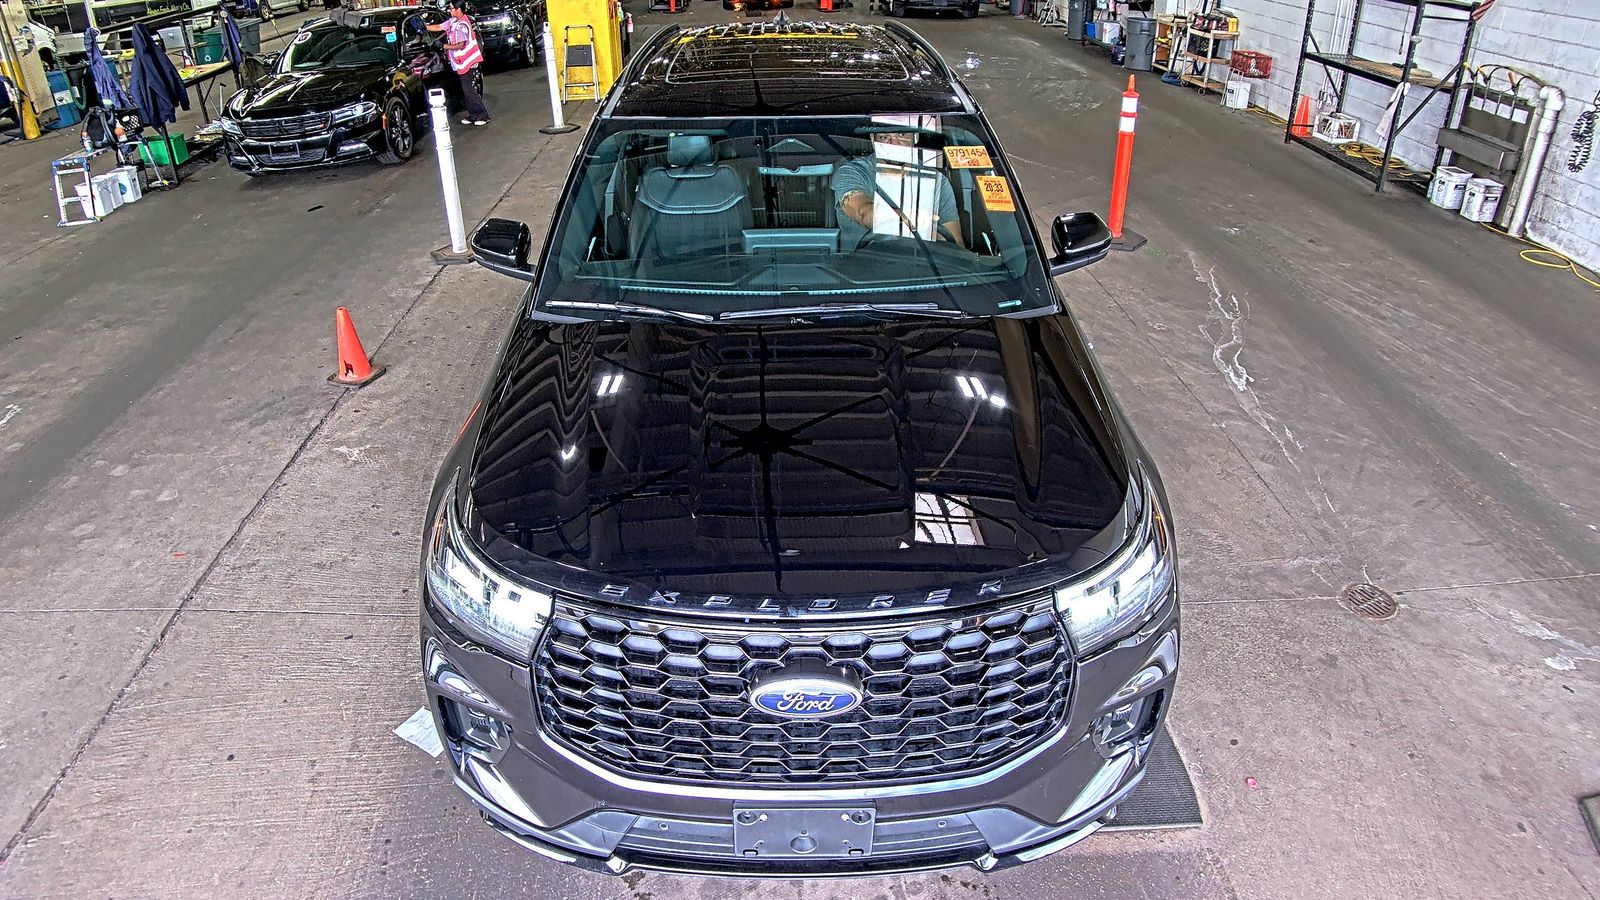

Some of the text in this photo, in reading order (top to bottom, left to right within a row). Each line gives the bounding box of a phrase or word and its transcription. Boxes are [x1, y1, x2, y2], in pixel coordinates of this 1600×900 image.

[947, 148, 988, 158] 9791454
[600, 579, 1001, 612] EXPLORER
[777, 689, 836, 711] Ford
